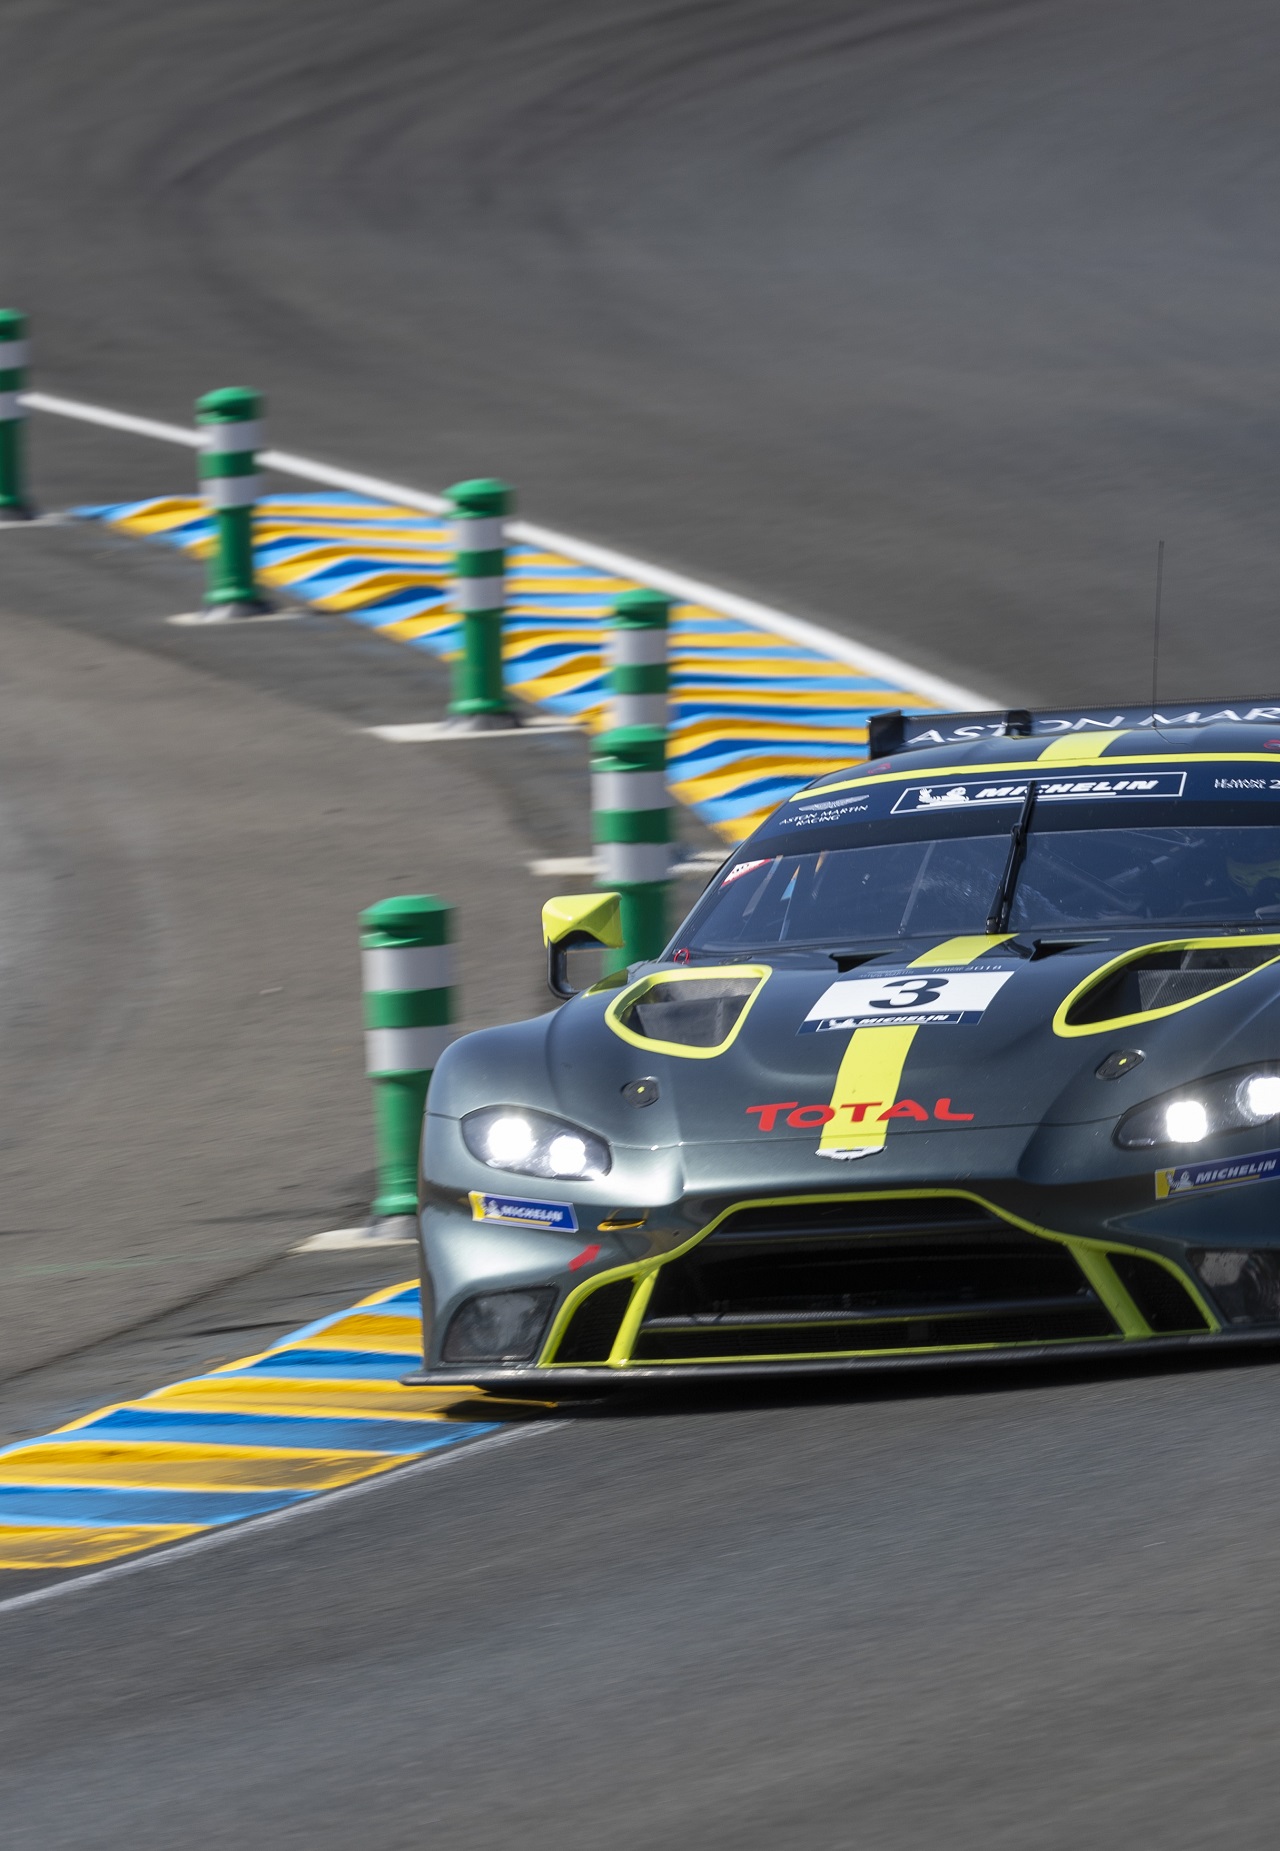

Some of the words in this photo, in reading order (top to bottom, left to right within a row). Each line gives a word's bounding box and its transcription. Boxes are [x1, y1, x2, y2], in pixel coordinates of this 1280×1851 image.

[779, 812, 818, 826] ASTON
[820, 804, 869, 817] MARTIN
[795, 814, 841, 827] RACING
[868, 977, 950, 1009] 3
[858, 1014, 950, 1025] MICHELIN
[746, 1098, 975, 1132] TOTAL
[1194, 1159, 1278, 1184] MICHELIN
[500, 1204, 564, 1222] MICHELIN
